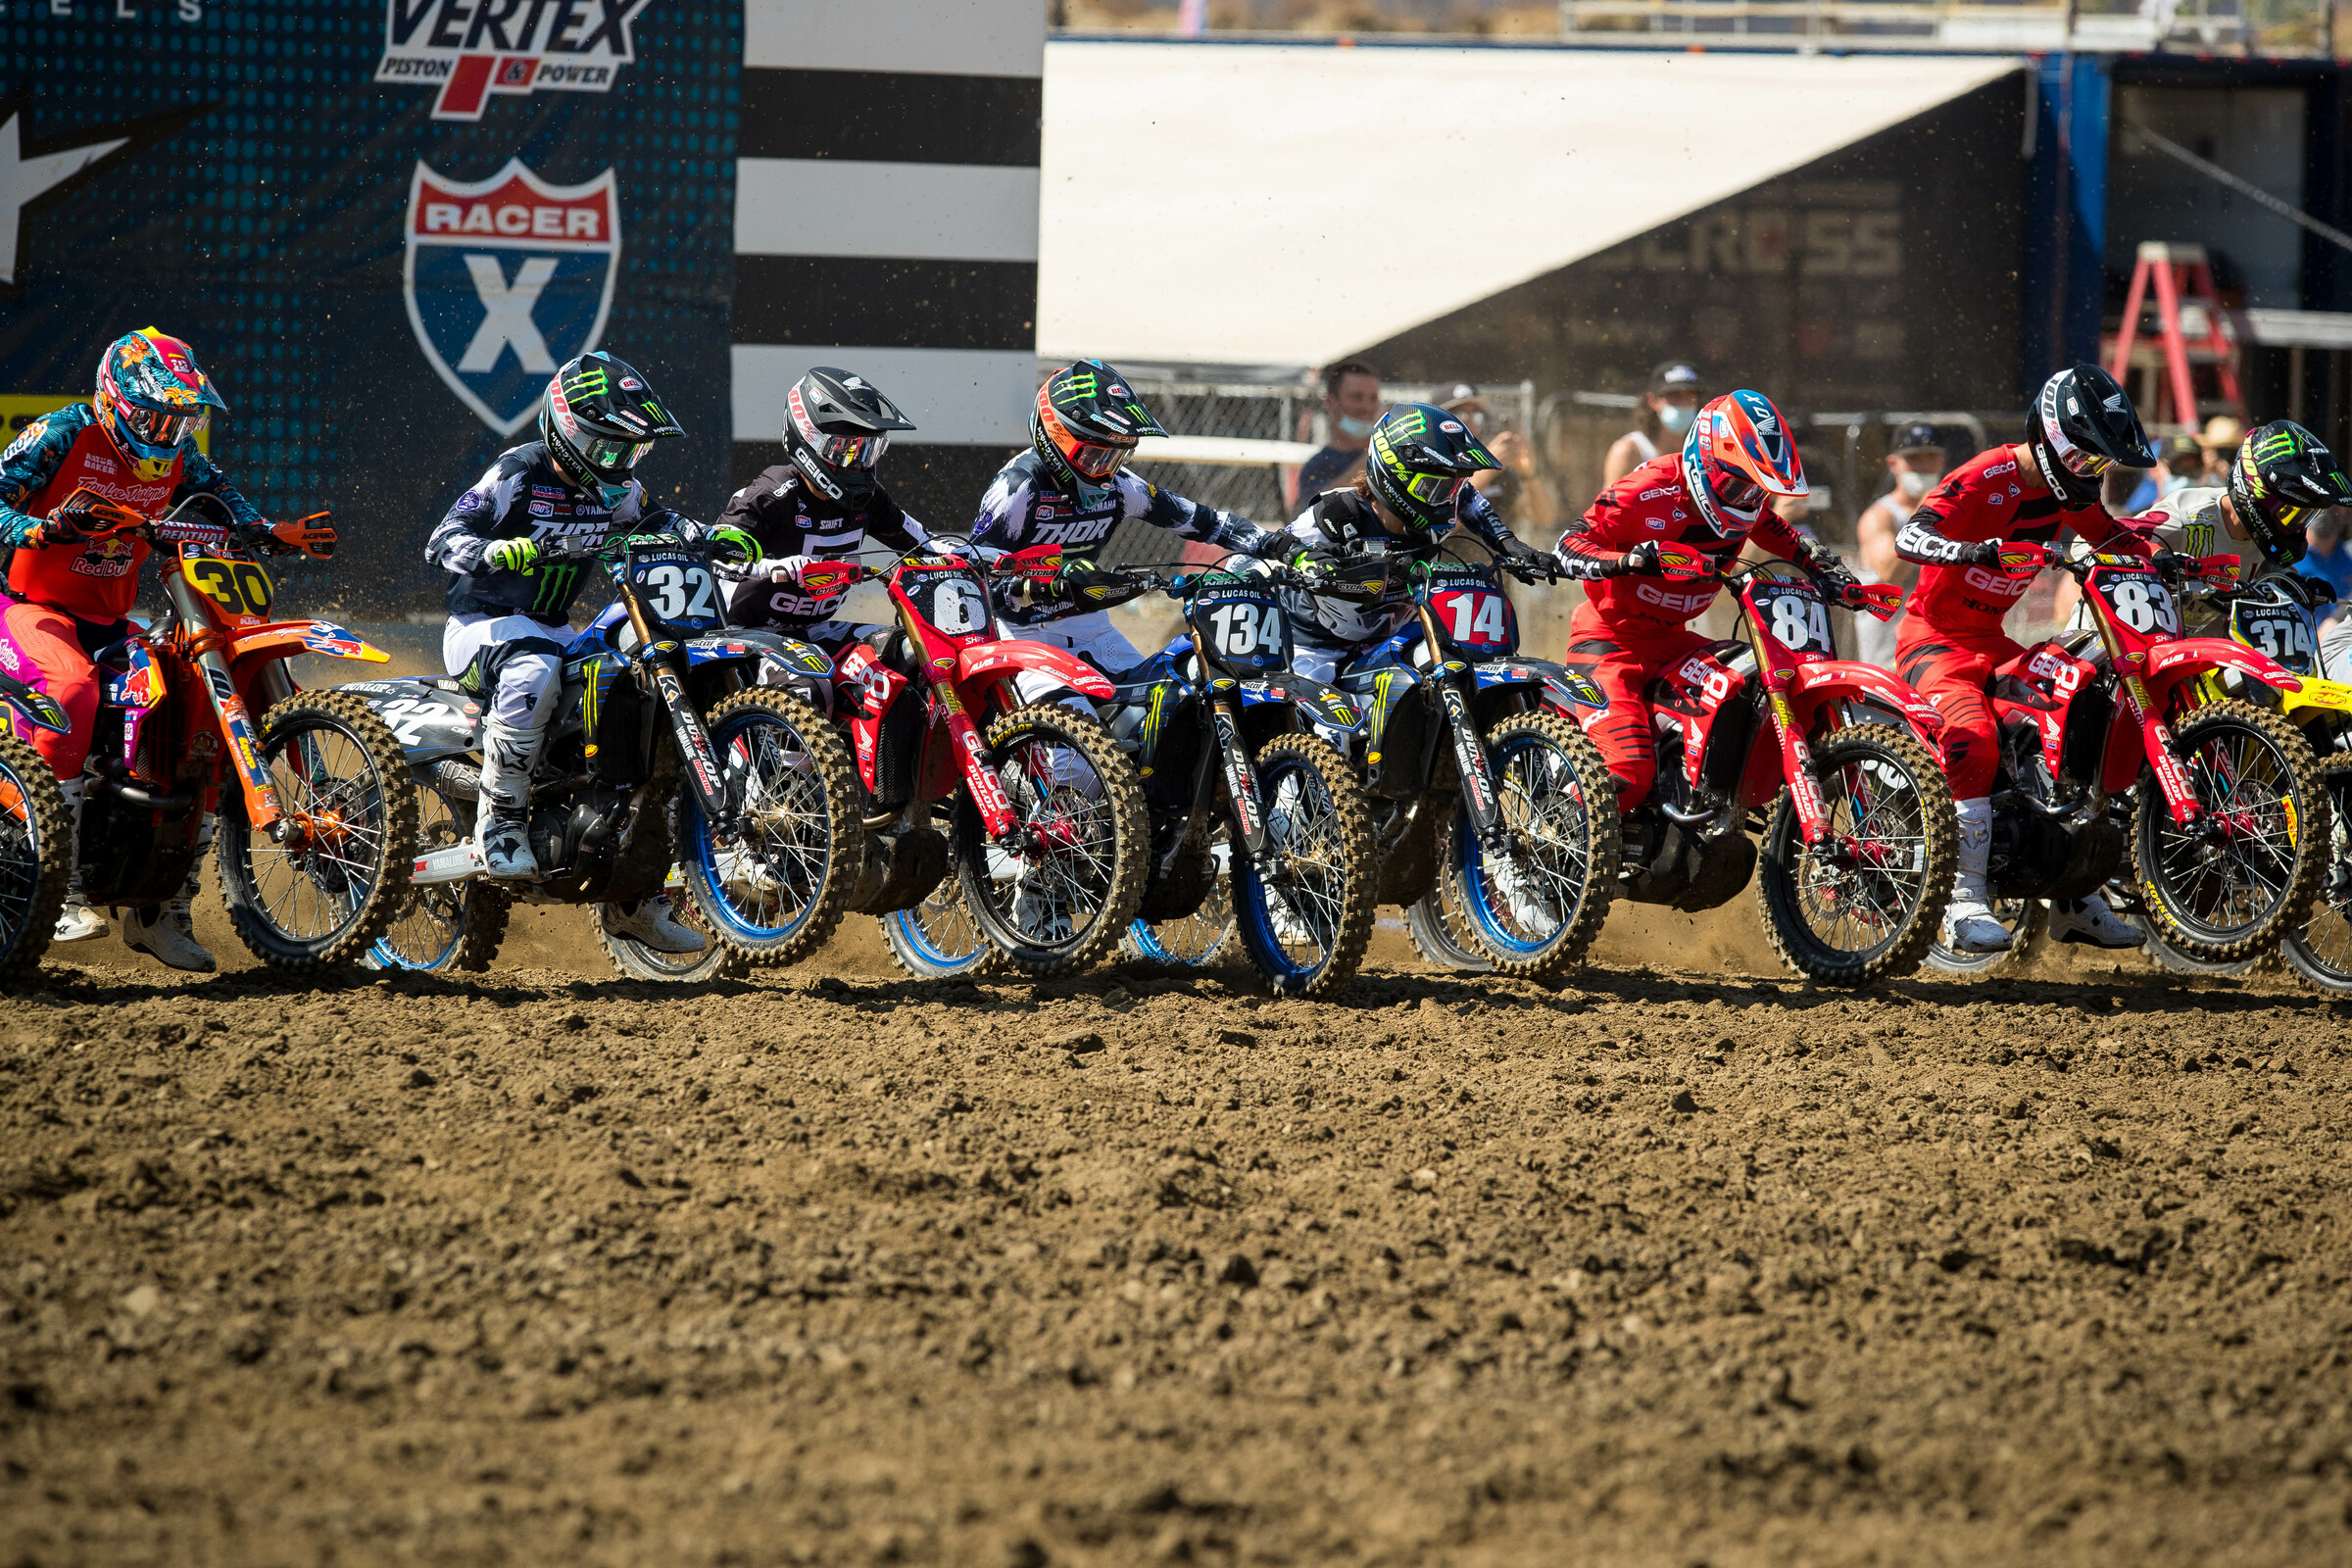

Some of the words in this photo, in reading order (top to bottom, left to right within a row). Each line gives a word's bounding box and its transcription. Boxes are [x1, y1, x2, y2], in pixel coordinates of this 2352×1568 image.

[382, 57, 453, 76] PISTON
[504, 61, 526, 82] &
[538, 64, 610, 84] POWER
[424, 203, 600, 238] RACER
[457, 254, 559, 373] X
[550, 431, 584, 474] MONSTER
[1037, 425, 1063, 470] MONSTER
[1373, 427, 1413, 481] 100%
[2240, 434, 2270, 500] 100%
[83, 460, 118, 476] BAKER
[794, 447, 844, 500] GEICO
[1983, 460, 2017, 479] GEICO
[2035, 442, 2068, 502] GEICO
[104, 482, 127, 500] Lee
[127, 484, 171, 507] Designs
[531, 502, 552, 514] 100%
[1382, 478, 1417, 517] MONSTER
[1639, 484, 1682, 502] GEICO
[1690, 466, 1723, 527] GEICO
[161, 529, 226, 544] RENTHAL
[819, 517, 844, 530] SHIFT
[1030, 516, 1114, 545] THOR
[1647, 519, 1663, 528] 100%
[2246, 499, 2274, 540] MONSTER
[221, 550, 234, 560] OIL
[651, 553, 676, 562] LUCAS
[677, 553, 689, 562] OIL
[1668, 567, 1697, 576] CYCRA
[2011, 564, 2038, 573] CYCRA
[194, 561, 273, 616] 30
[647, 564, 715, 620] 32
[929, 570, 953, 580] LUCAS
[1221, 590, 1249, 599] LUCAS
[1449, 578, 1474, 587] LUCAS
[1781, 587, 1802, 597] LUCAS
[1803, 589, 1813, 599] OIL
[1964, 566, 2032, 597] GEIC
[2122, 572, 2143, 581] LUCAS
[934, 578, 987, 635] 6
[1446, 592, 1505, 643] 14
[1772, 595, 1832, 653] 84
[2113, 580, 2179, 634] 83
[2255, 608, 2279, 617] LUCAS
[2280, 609, 2291, 617] OIL
[1209, 603, 1283, 656] 134
[2249, 619, 2315, 659] 374
[339, 682, 392, 693] DUNLOP
[437, 679, 460, 692] YAMAHA
[841, 652, 890, 700] GEICO
[1072, 675, 1111, 686] GEICO
[1679, 657, 1729, 700] GEICO
[2028, 651, 2081, 691] GEICO
[379, 699, 450, 746] 32
[990, 723, 1033, 749] DUNLOP
[2044, 733, 2061, 742] HONDA
[679, 710, 722, 788] DULOP
[1461, 727, 1494, 805] DULOP
[693, 760, 714, 796] BRAKING
[961, 730, 1011, 810] GICO
[967, 763, 997, 812] DUNLOP
[1231, 748, 1261, 829] DULOP
[2156, 766, 2177, 807] WISECO
[2158, 755, 2183, 802] DUNLOP
[965, 776, 990, 817] WISECO
[1468, 775, 1486, 811] BRAKING
[1789, 782, 1808, 824] WISECO
[1793, 770, 1815, 819] DUNLOP
[1236, 798, 1252, 835] BRAKING
[431, 854, 466, 870] YAMALUBE
[2146, 880, 2180, 927] DUNLOP
